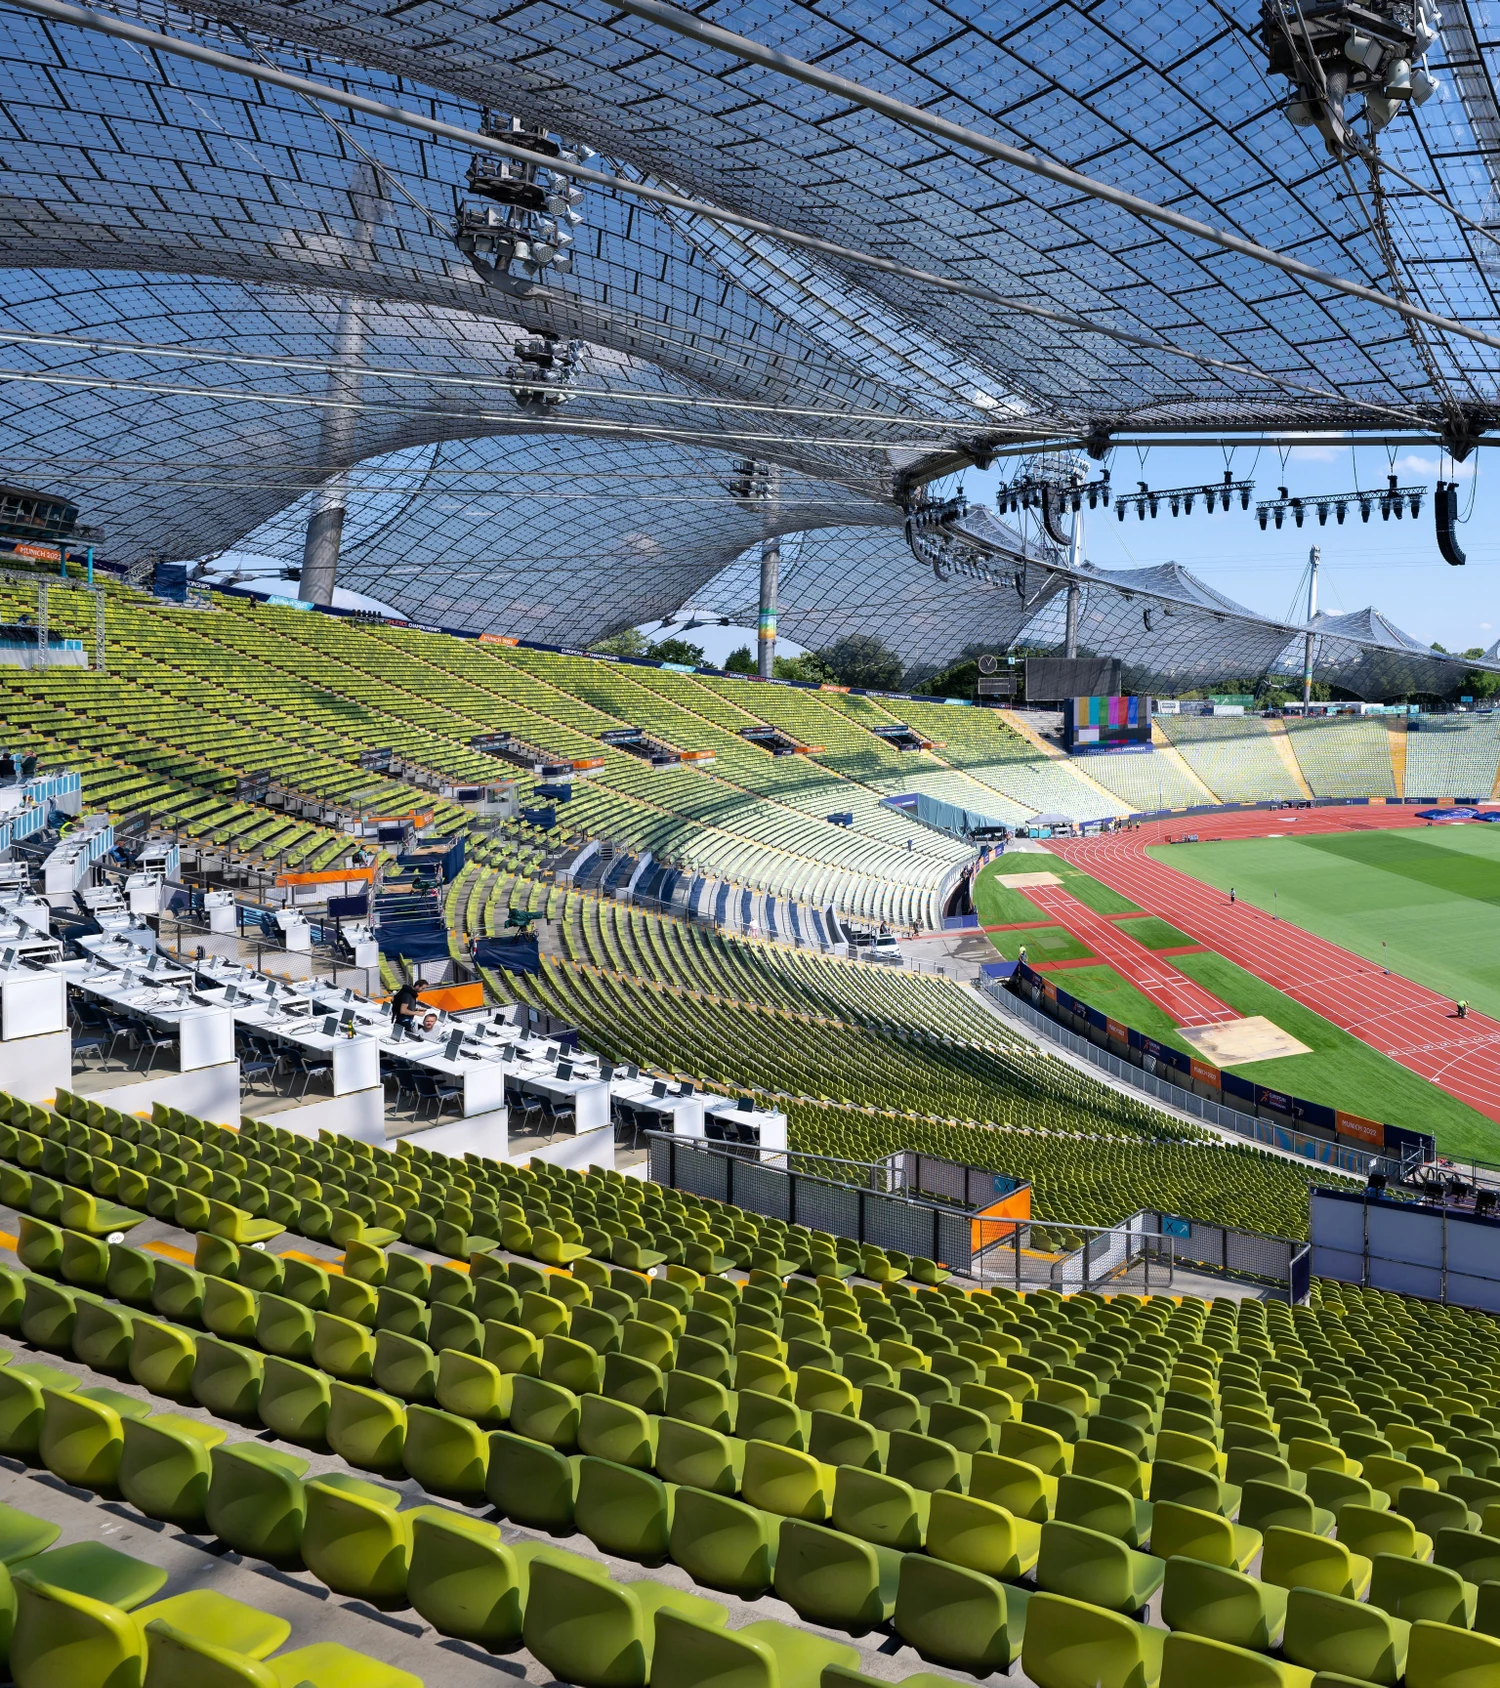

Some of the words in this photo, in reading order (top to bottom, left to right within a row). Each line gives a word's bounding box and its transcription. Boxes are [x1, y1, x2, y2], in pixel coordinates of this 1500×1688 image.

[20, 546, 45, 558] MUNICH
[1342, 1120, 1362, 1132] MUNICH
[1363, 1127, 1377, 1137] 2022
